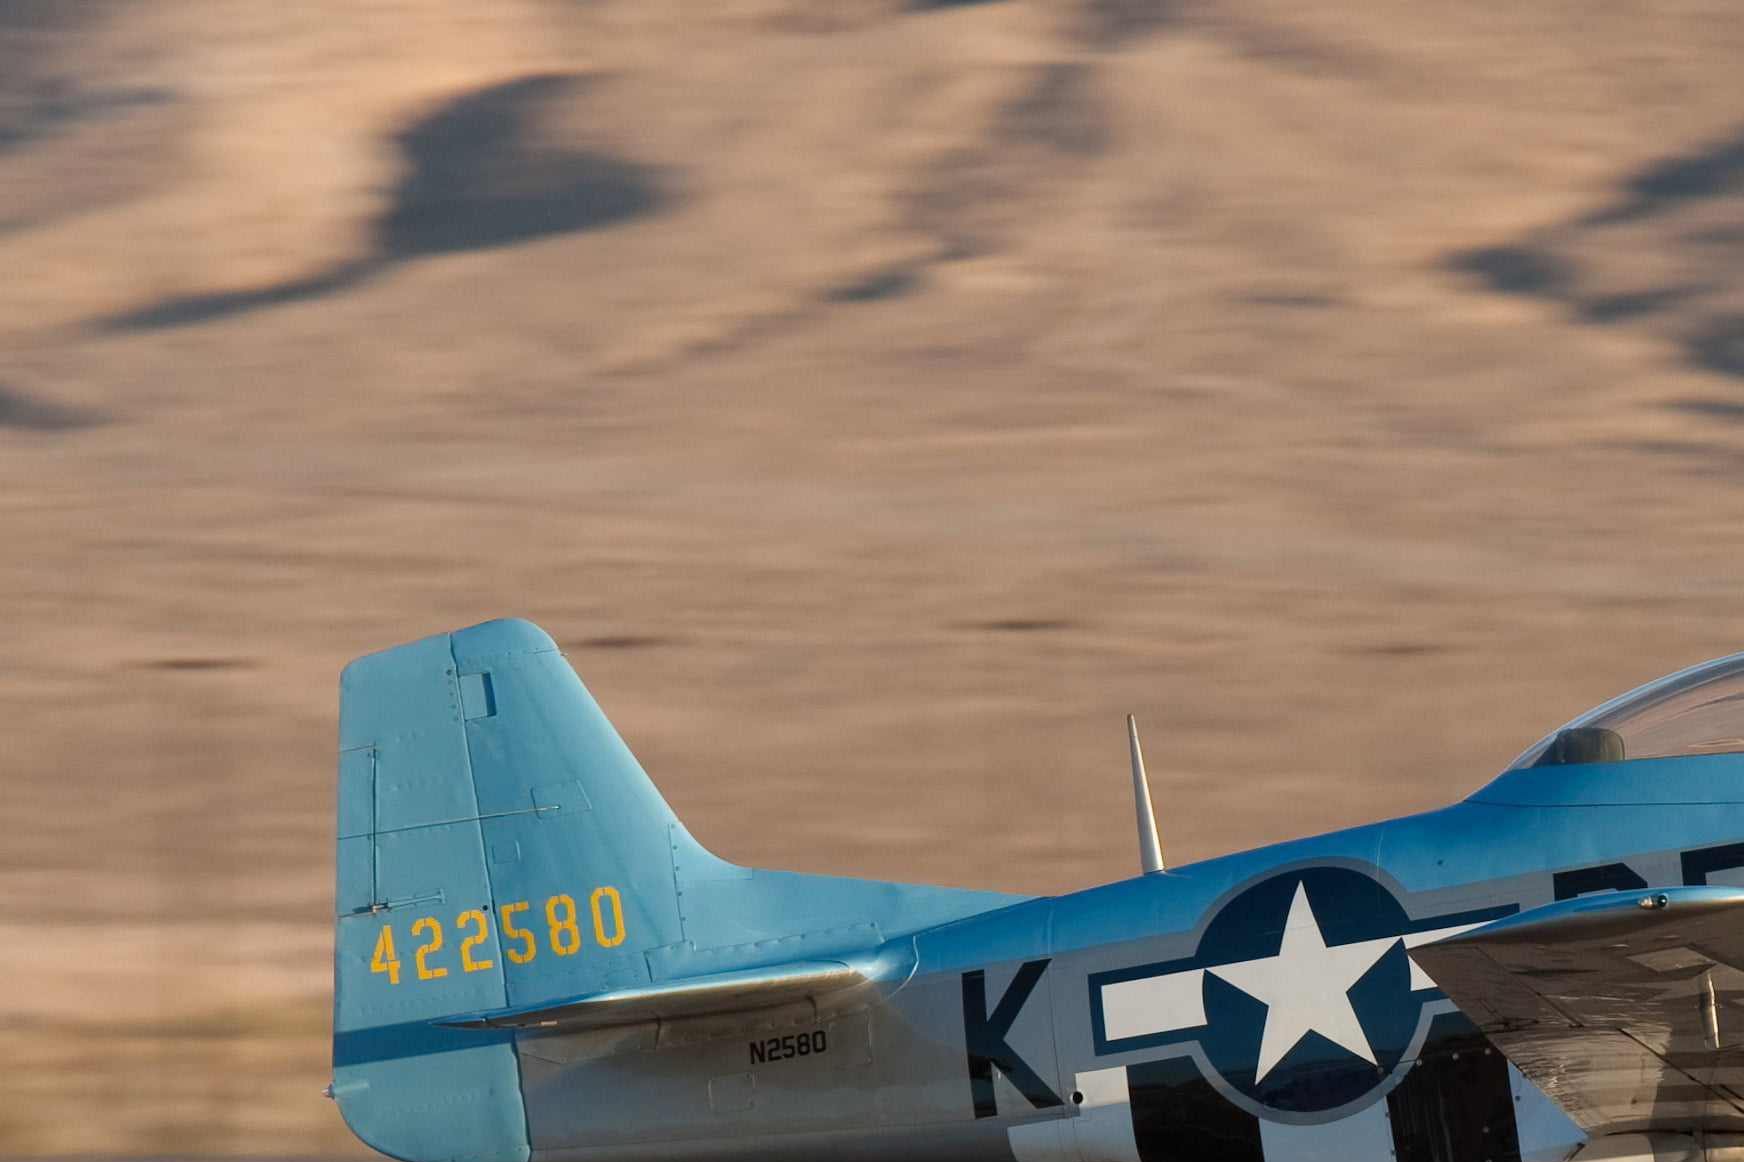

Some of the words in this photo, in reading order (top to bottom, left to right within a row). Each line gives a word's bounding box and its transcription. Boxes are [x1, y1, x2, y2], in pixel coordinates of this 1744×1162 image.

[370, 885, 627, 985] 422580
[749, 1029, 827, 1065] N2580
[960, 957, 1064, 1121] K
